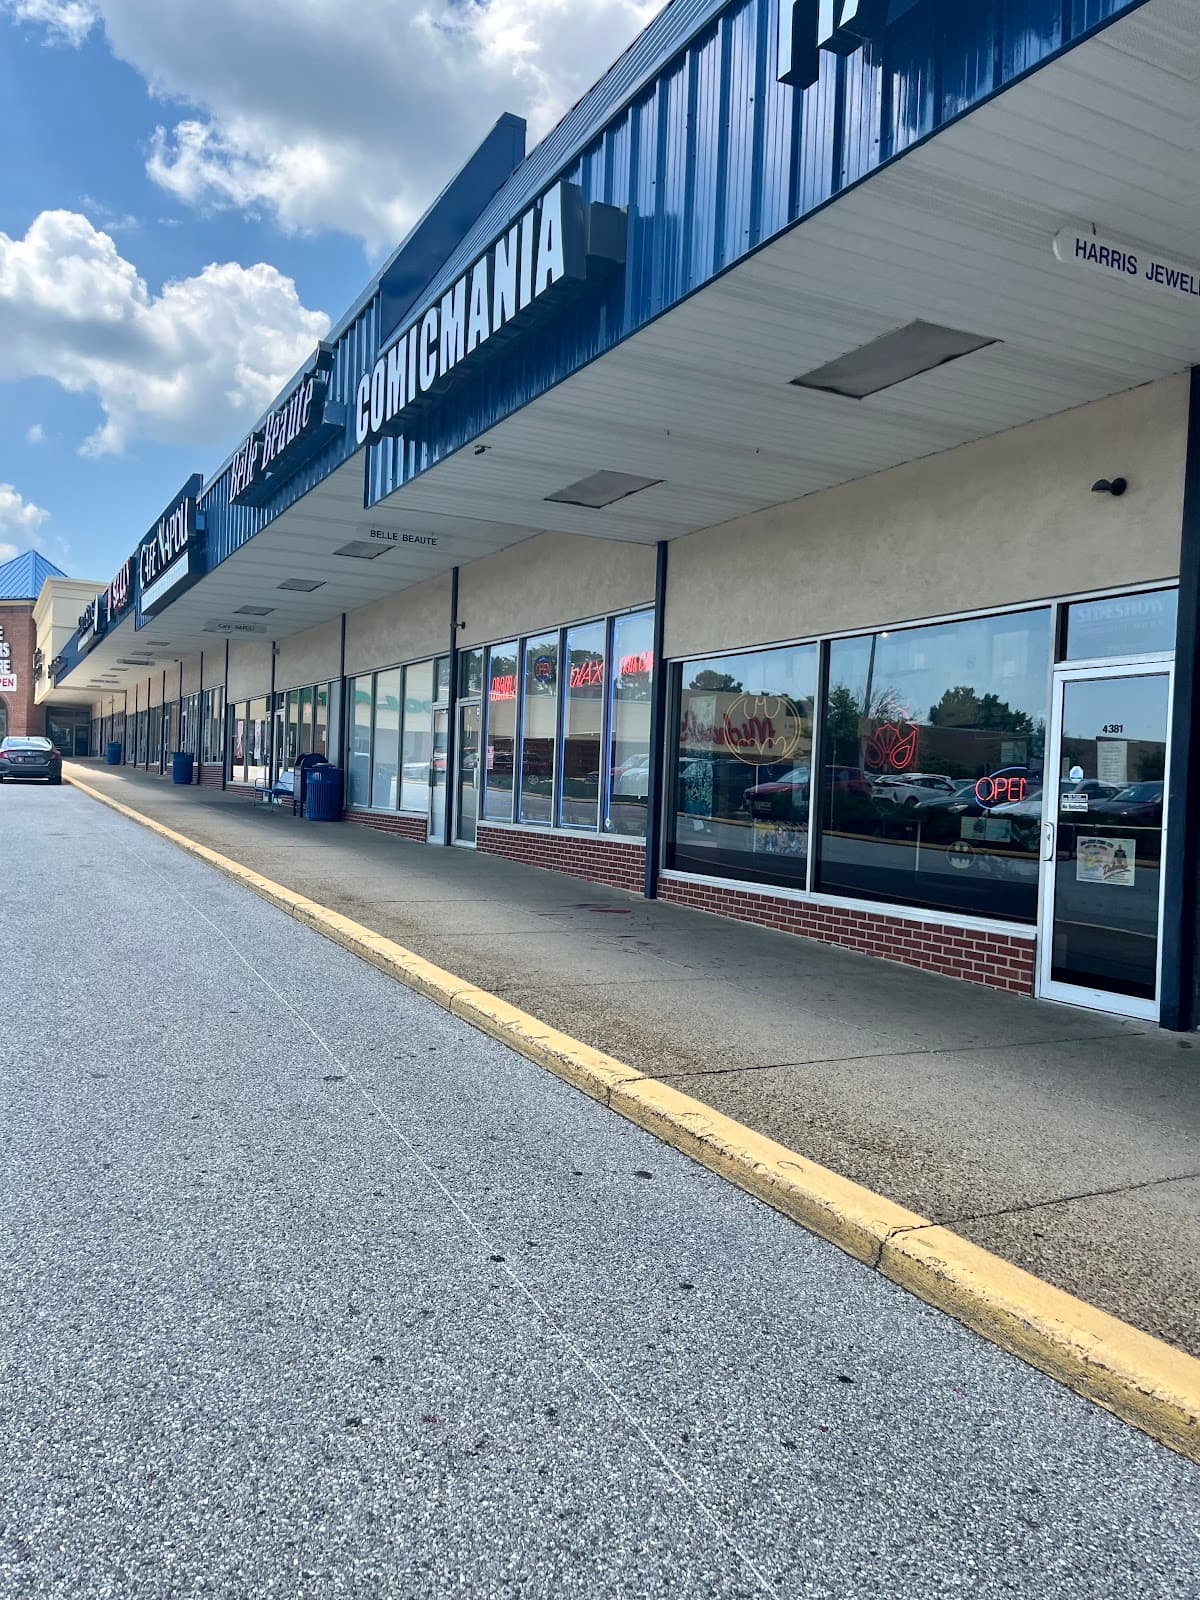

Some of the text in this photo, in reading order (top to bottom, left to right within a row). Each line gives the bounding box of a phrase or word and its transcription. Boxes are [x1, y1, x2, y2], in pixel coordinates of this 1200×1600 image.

[1075, 238, 1200, 297] HARRIS JEWEL
[356, 181, 565, 444] COMICMANIA
[229, 436, 258, 503] Belle
[370, 530, 438, 546] BELLE BEAUTE
[569, 659, 603, 687] WAX
[1102, 724, 1123, 734] 4381
